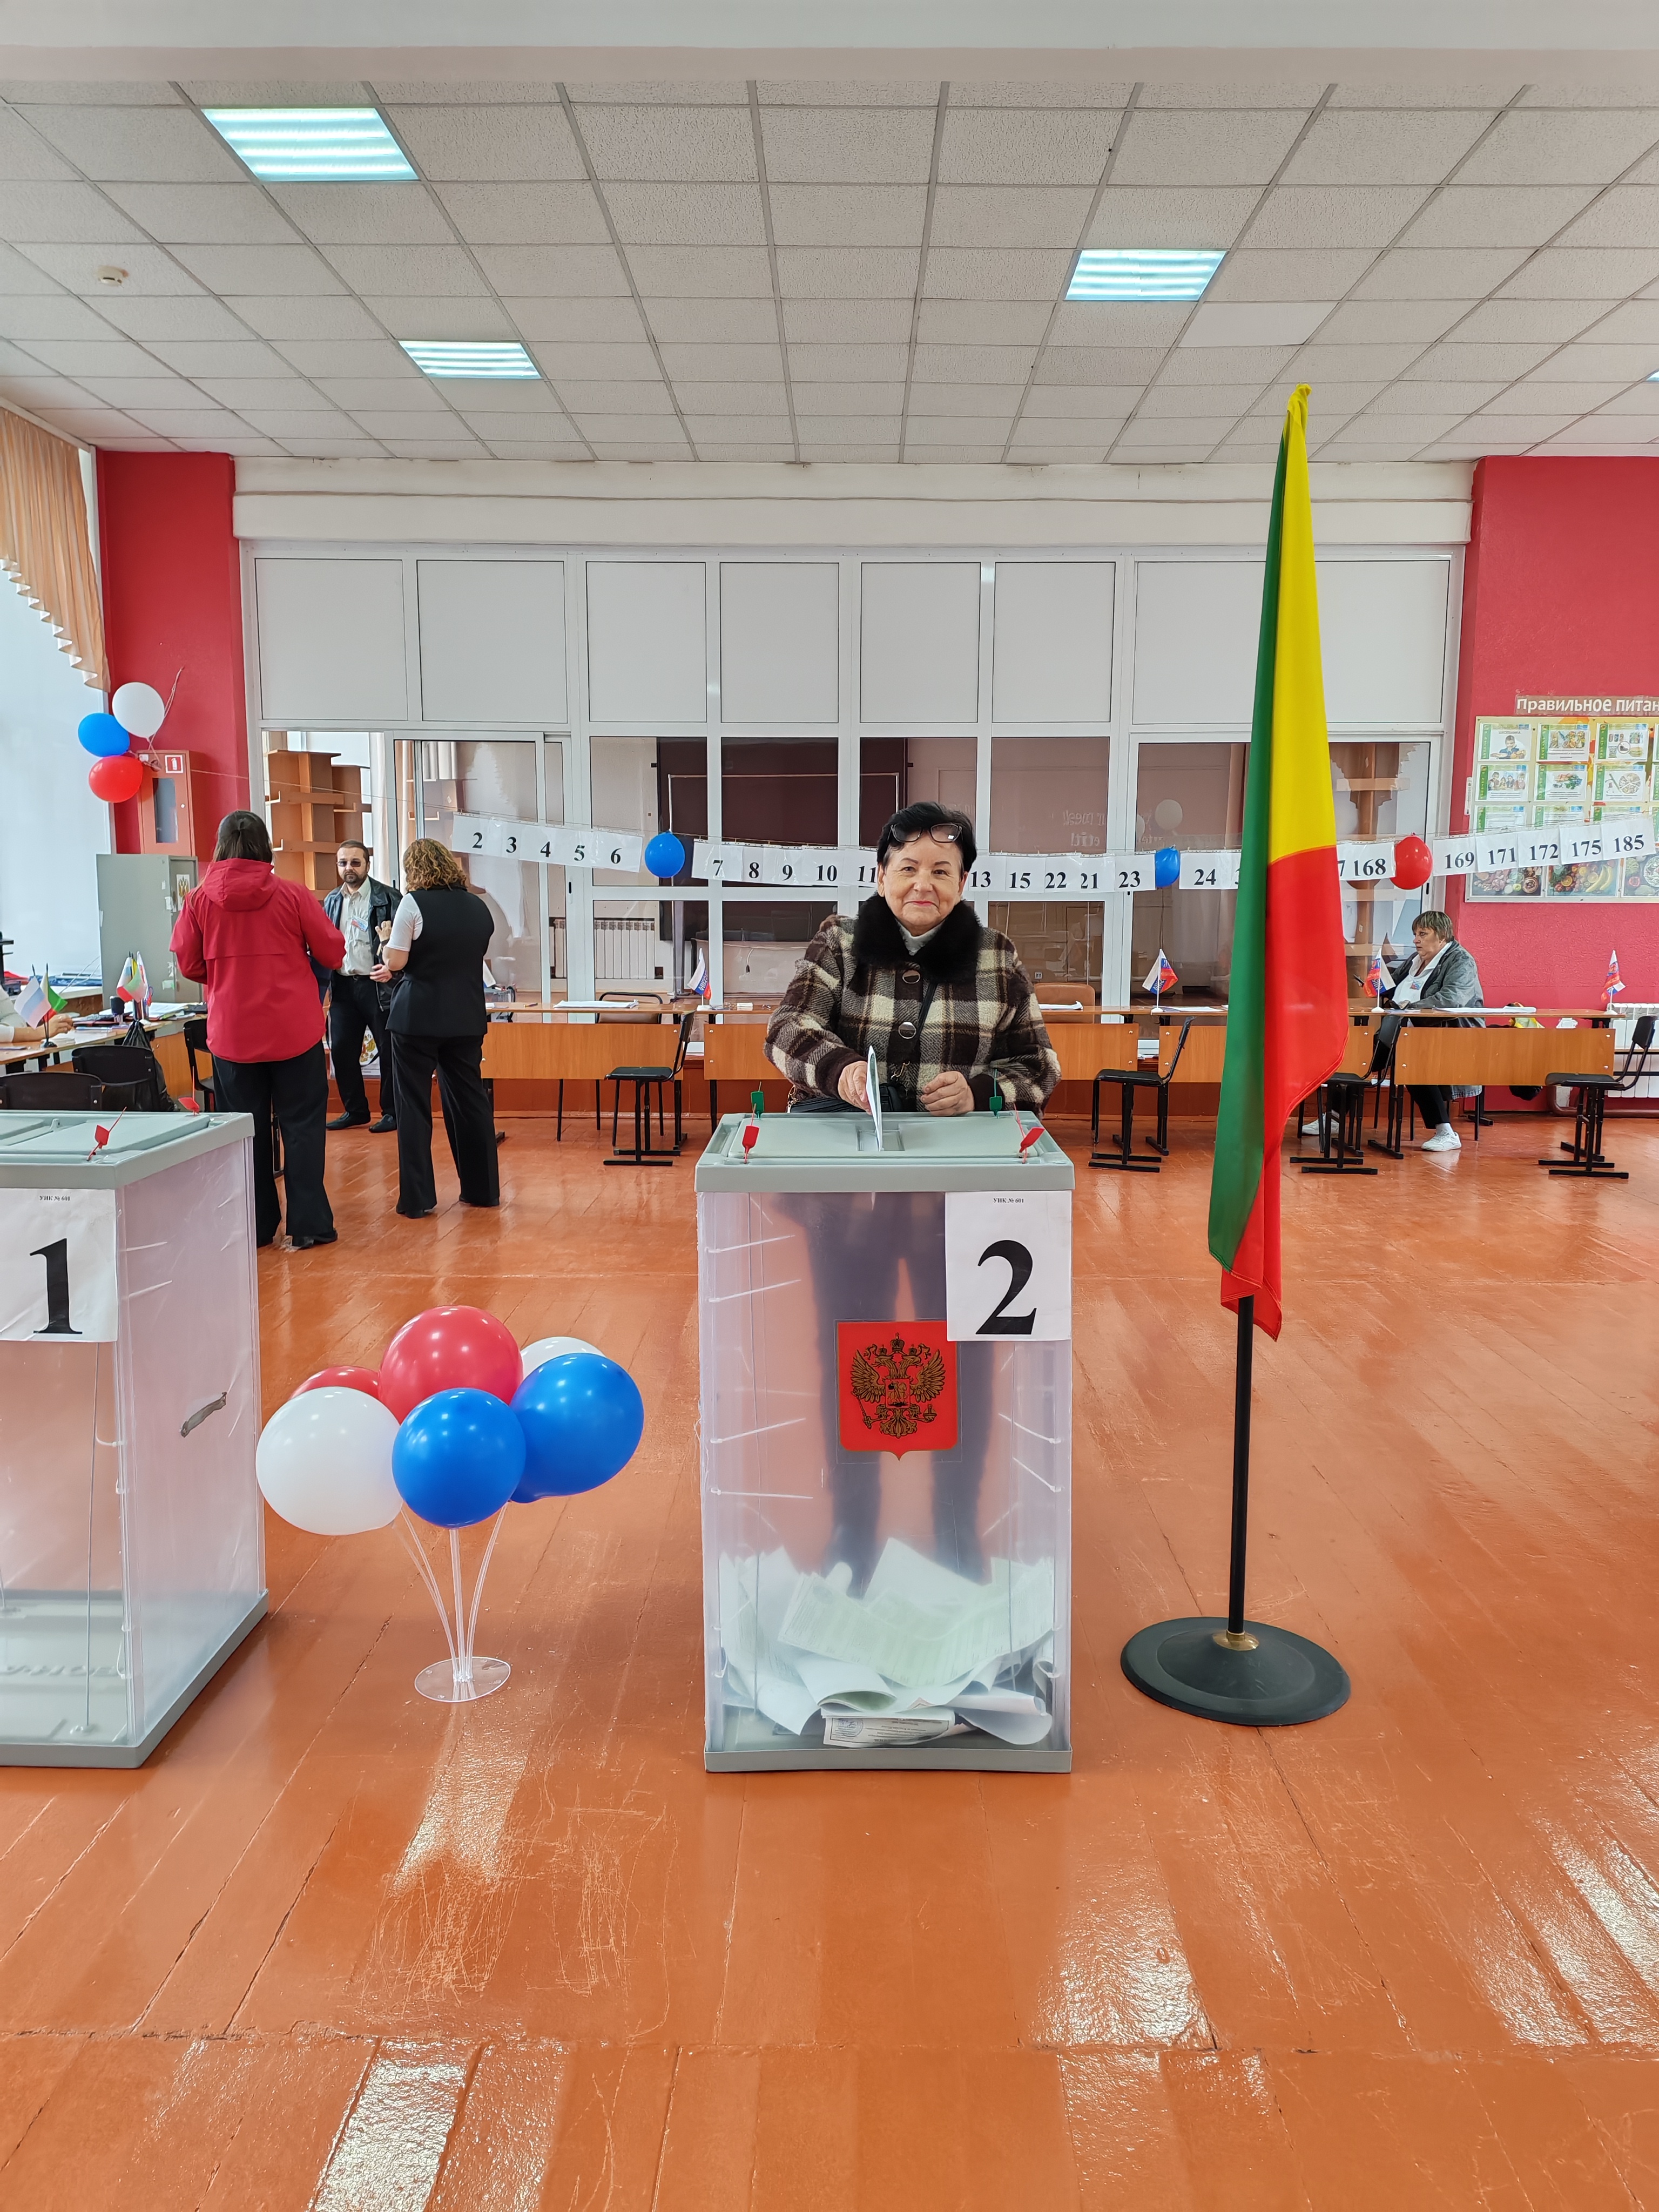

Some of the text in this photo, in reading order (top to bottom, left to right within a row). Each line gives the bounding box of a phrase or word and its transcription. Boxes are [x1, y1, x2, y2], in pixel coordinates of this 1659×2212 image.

[1516, 698, 1612, 713] Правильное
[472, 832, 621, 864] 2 3 4 5 6
[1445, 834, 1644, 869] 169 171 172 175 185
[713, 859, 876, 884] 7 8 9 10 11
[1193, 868, 1216, 885] 24
[1354, 858, 1386, 876] 168
[971, 871, 1141, 889] 13 15 22 21 23
[29, 1238, 83, 1334] 1
[975, 1239, 1037, 1335] 2
